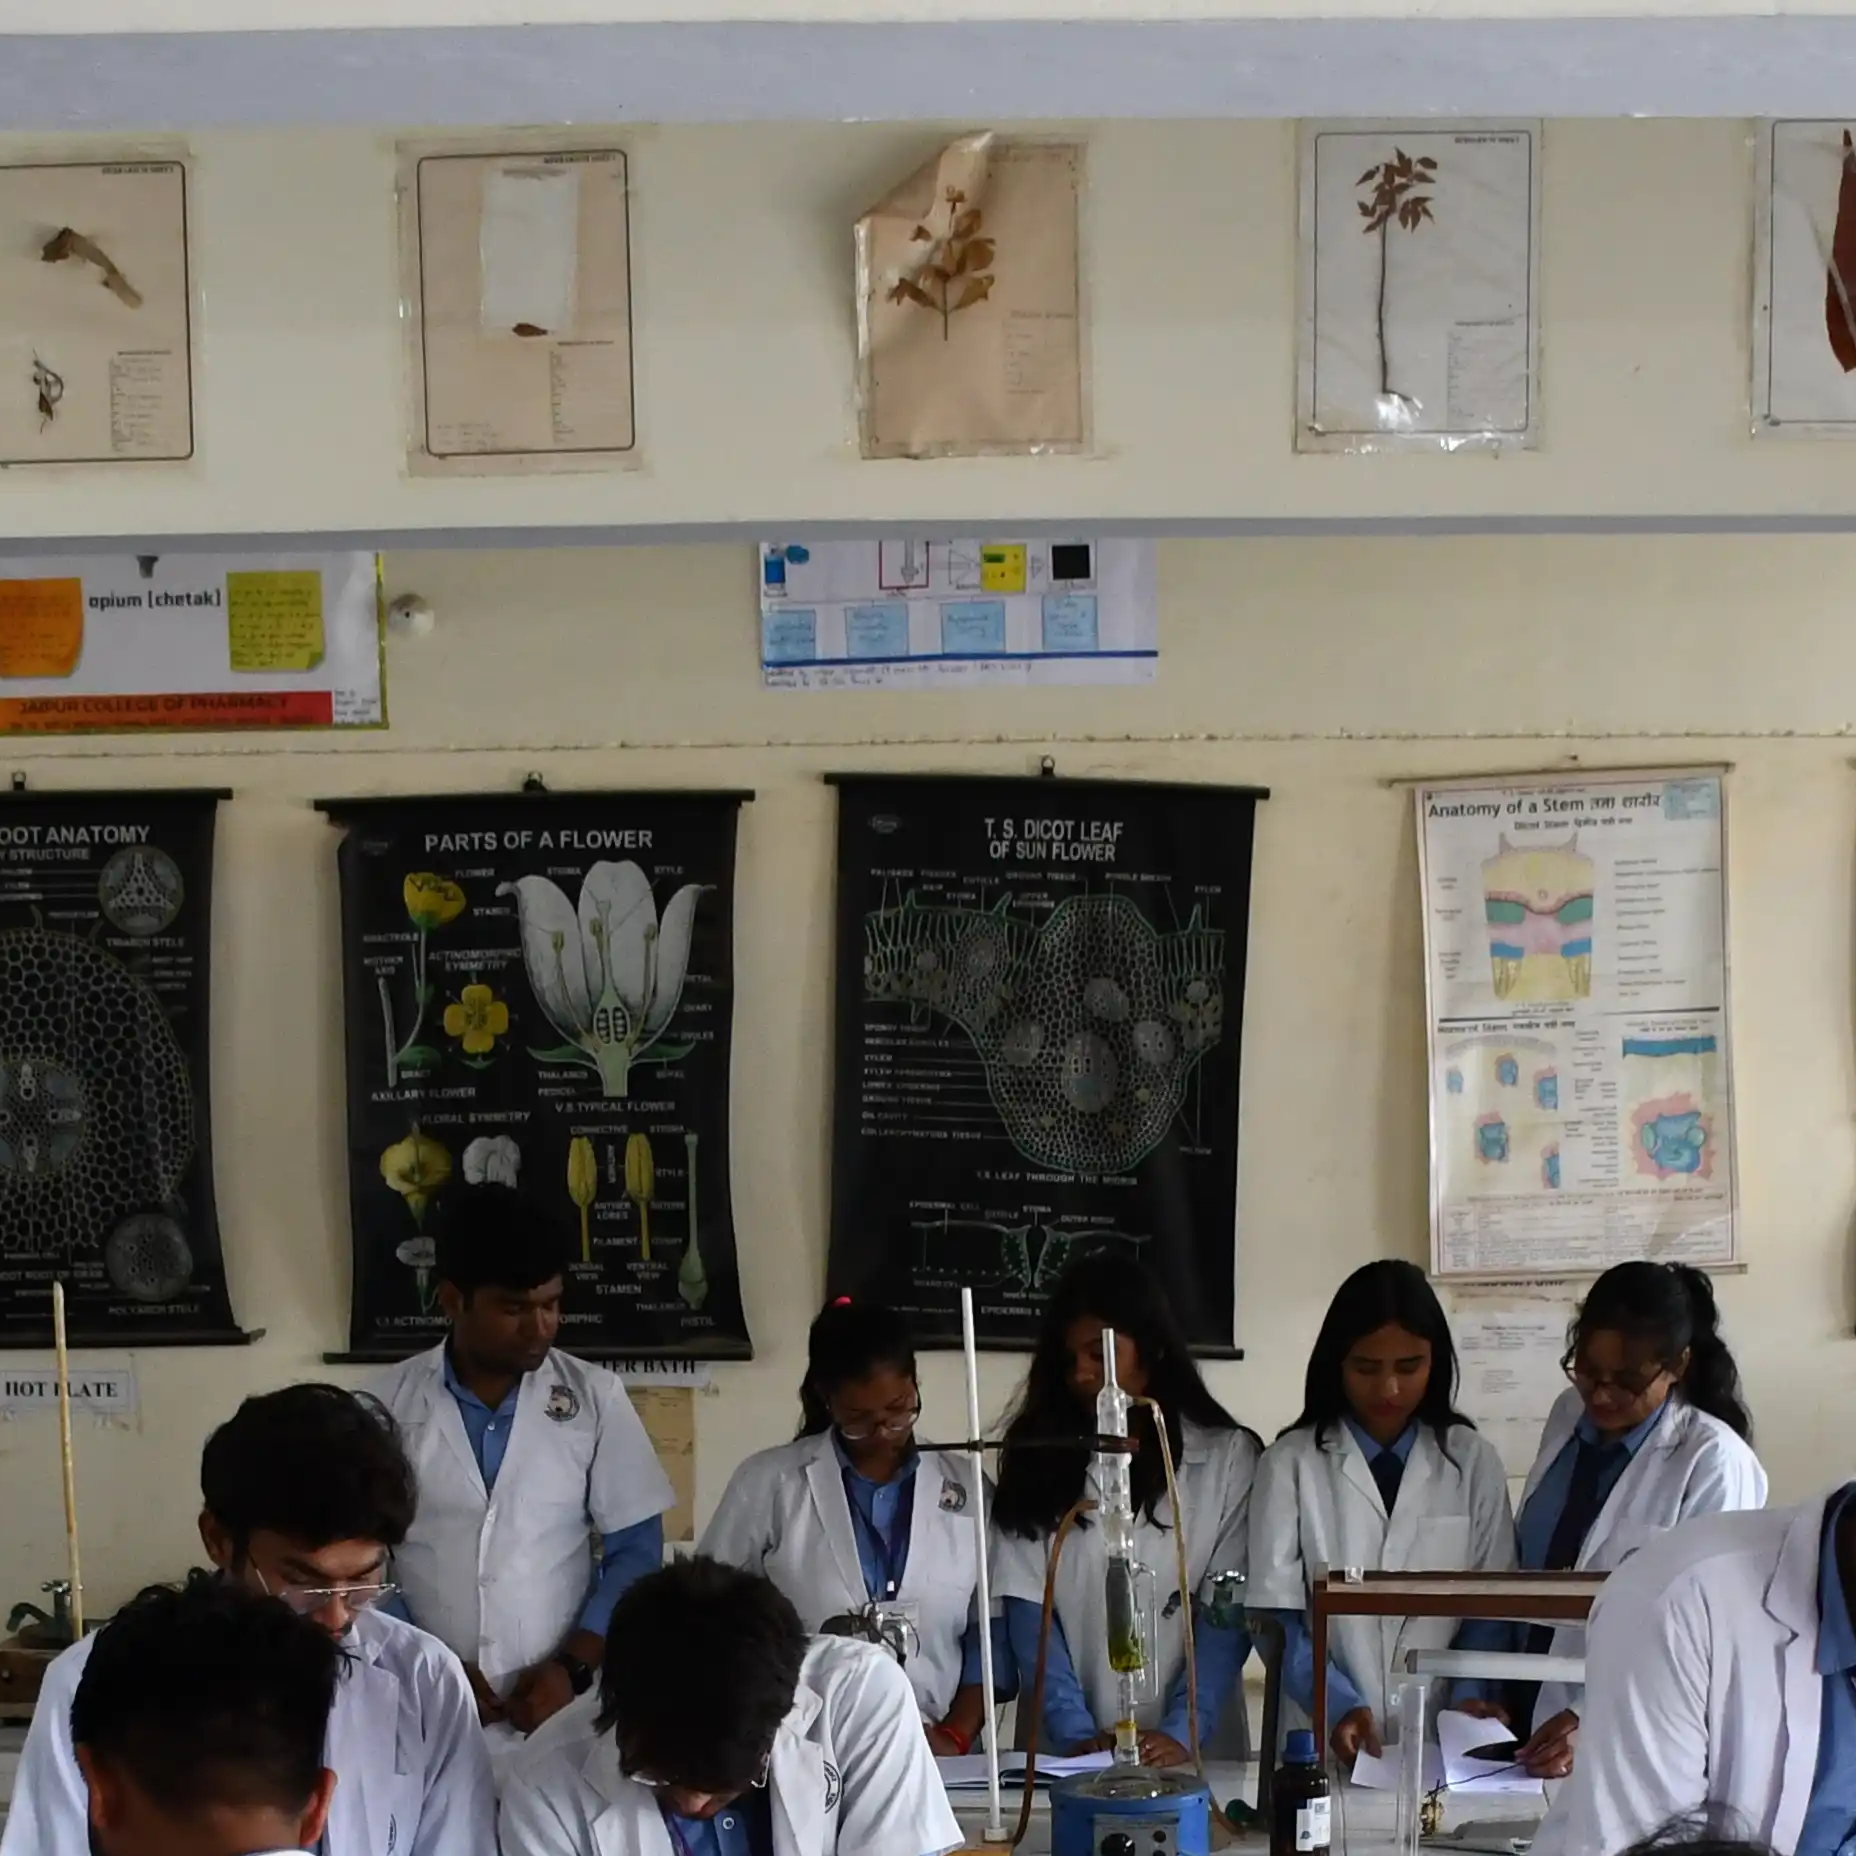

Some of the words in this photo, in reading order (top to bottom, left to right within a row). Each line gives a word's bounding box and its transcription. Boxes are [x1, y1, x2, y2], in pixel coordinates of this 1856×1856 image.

[89, 592, 142, 610] opium
[148, 588, 222, 609] [chetak]
[162, 697, 185, 711] OF
[1428, 801, 1501, 819] Anatomy
[1506, 799, 1522, 815] of
[1528, 804, 1538, 814] a
[1543, 798, 1585, 813] Stem
[46, 824, 151, 845] ANATOMY
[984, 818, 997, 839] T.
[1002, 818, 1018, 840] S.
[1024, 819, 1075, 841] DICOT
[1080, 821, 1124, 842] LEAF
[425, 832, 497, 853] PARTS
[503, 831, 533, 850] OF
[538, 831, 555, 849] A
[559, 829, 654, 849] FLOWER
[989, 841, 1010, 859] OF
[1015, 841, 1047, 860] SUN
[1051, 842, 1116, 862] FLOWER
[9, 847, 90, 862] STRUCTURE
[6, 1381, 48, 1397] HOT
